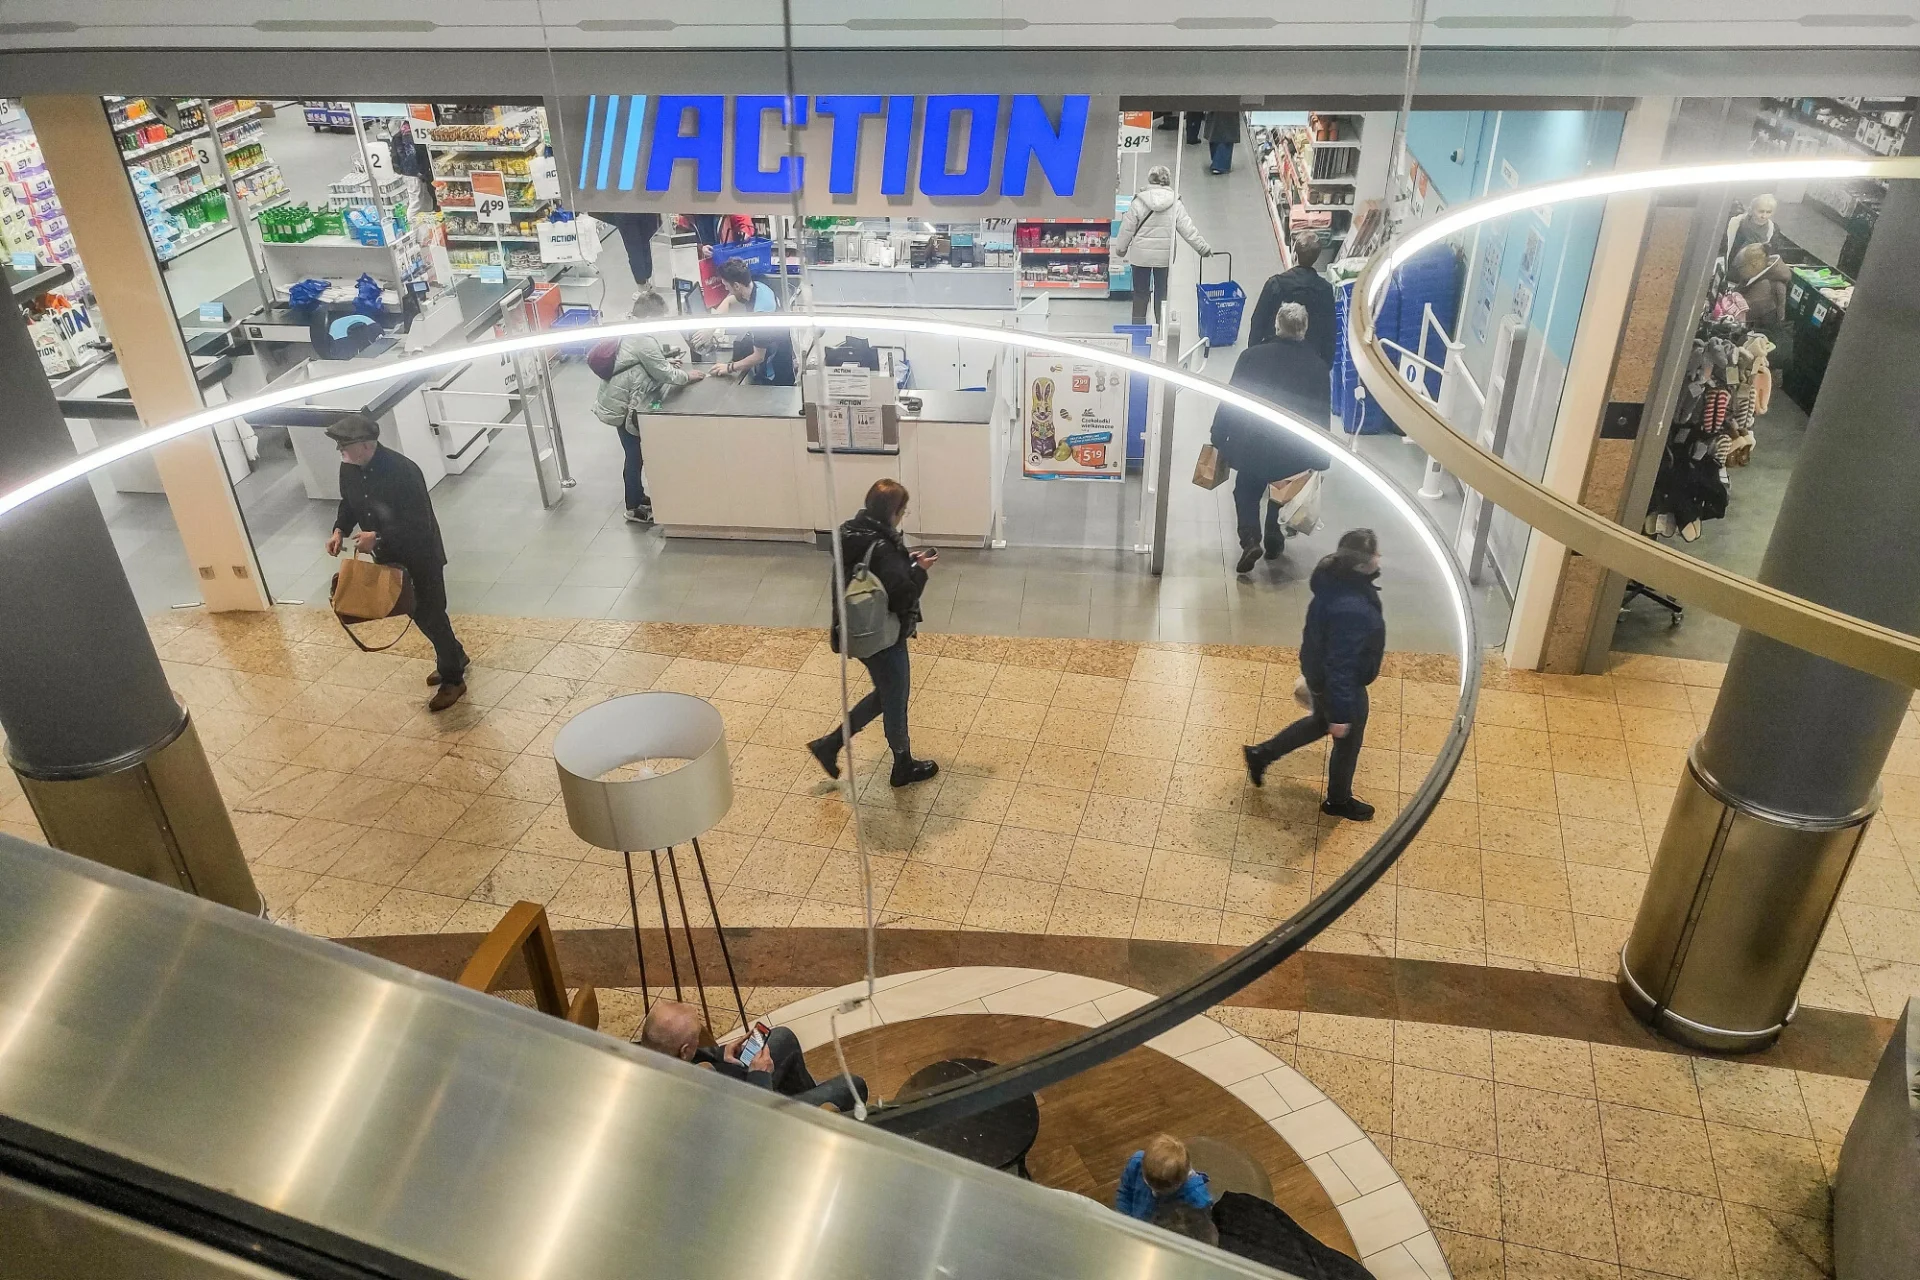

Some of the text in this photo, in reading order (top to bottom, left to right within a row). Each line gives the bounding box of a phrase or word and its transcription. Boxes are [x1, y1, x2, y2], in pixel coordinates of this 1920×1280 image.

[646, 95, 1090, 197] ACTION
[1124, 136, 1150, 148] 8475
[198, 149, 210, 164] 3
[371, 153, 382, 168] 2
[546, 169, 557, 178] AC
[480, 200, 504, 217] 499
[551, 234, 577, 243] ACTION
[1083, 450, 1102, 461] 519
